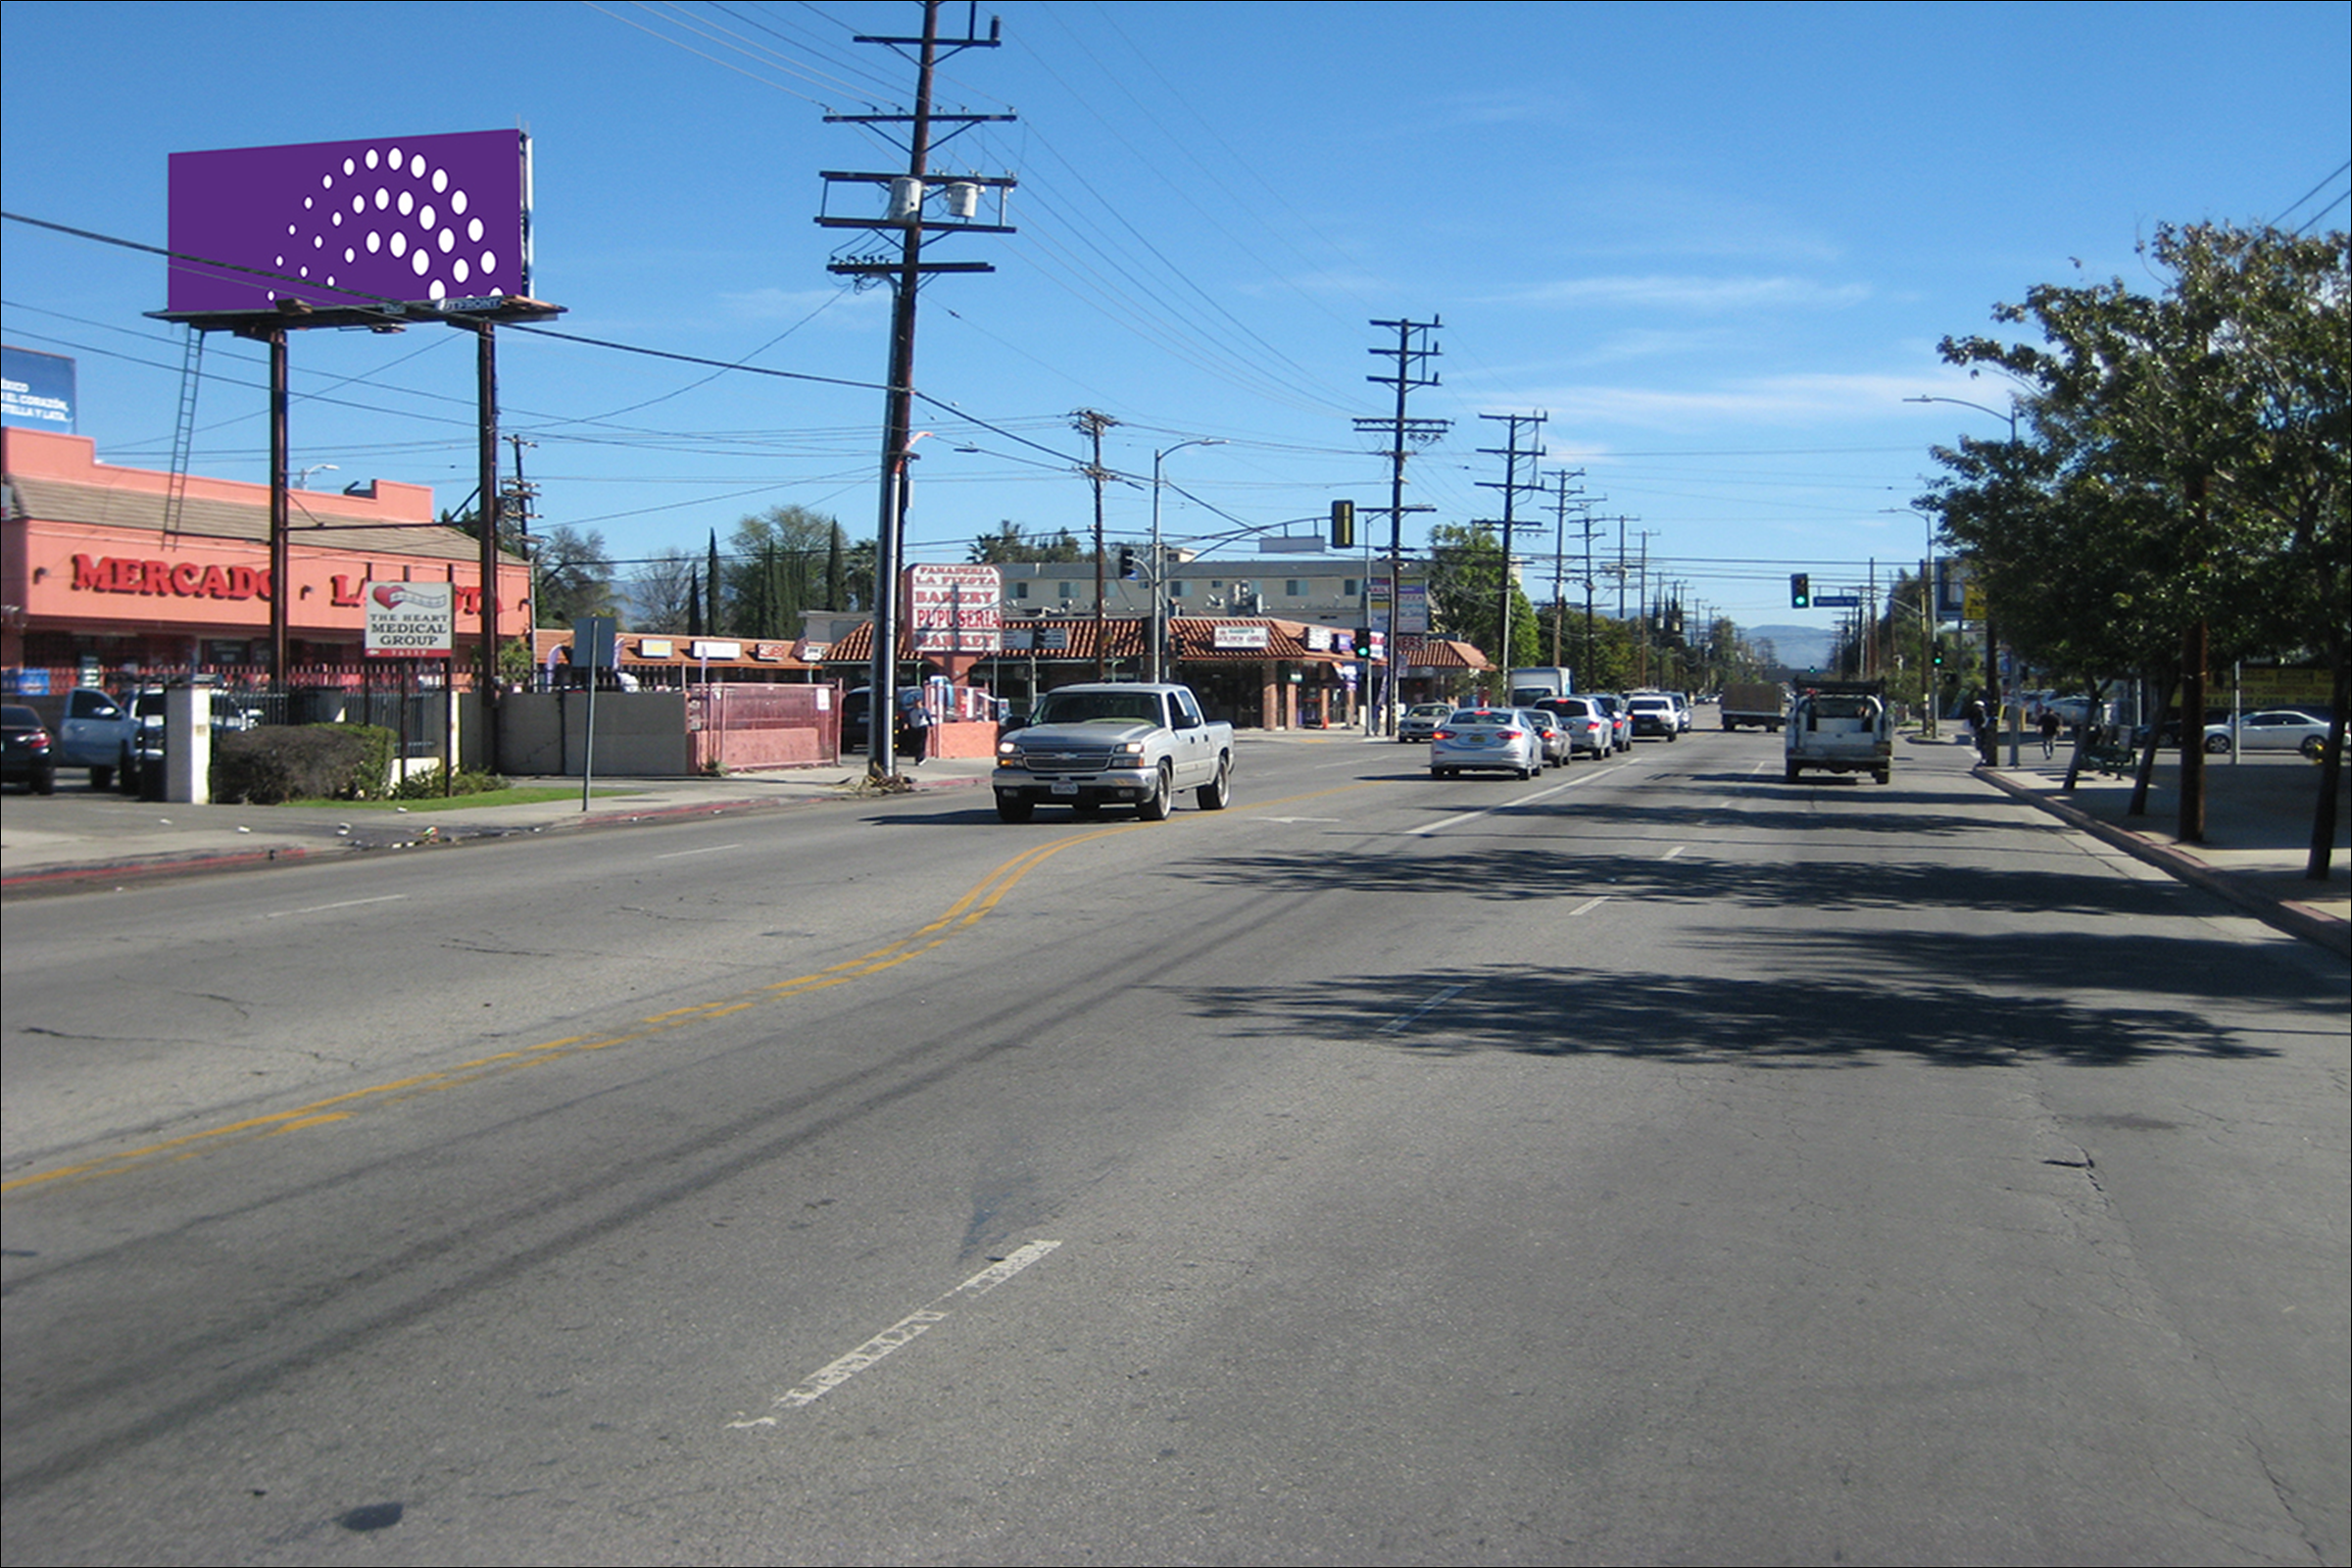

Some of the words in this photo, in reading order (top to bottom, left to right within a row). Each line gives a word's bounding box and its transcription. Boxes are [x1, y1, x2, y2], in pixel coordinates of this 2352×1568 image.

[915, 575, 936, 584] LA
[942, 575, 997, 584] FIESTA
[915, 590, 996, 604] BAKERY
[917, 610, 1002, 627] PUPUSERIA
[371, 623, 447, 633] MEDICAL
[380, 635, 438, 646] GROUP
[915, 634, 996, 648] MARKET
